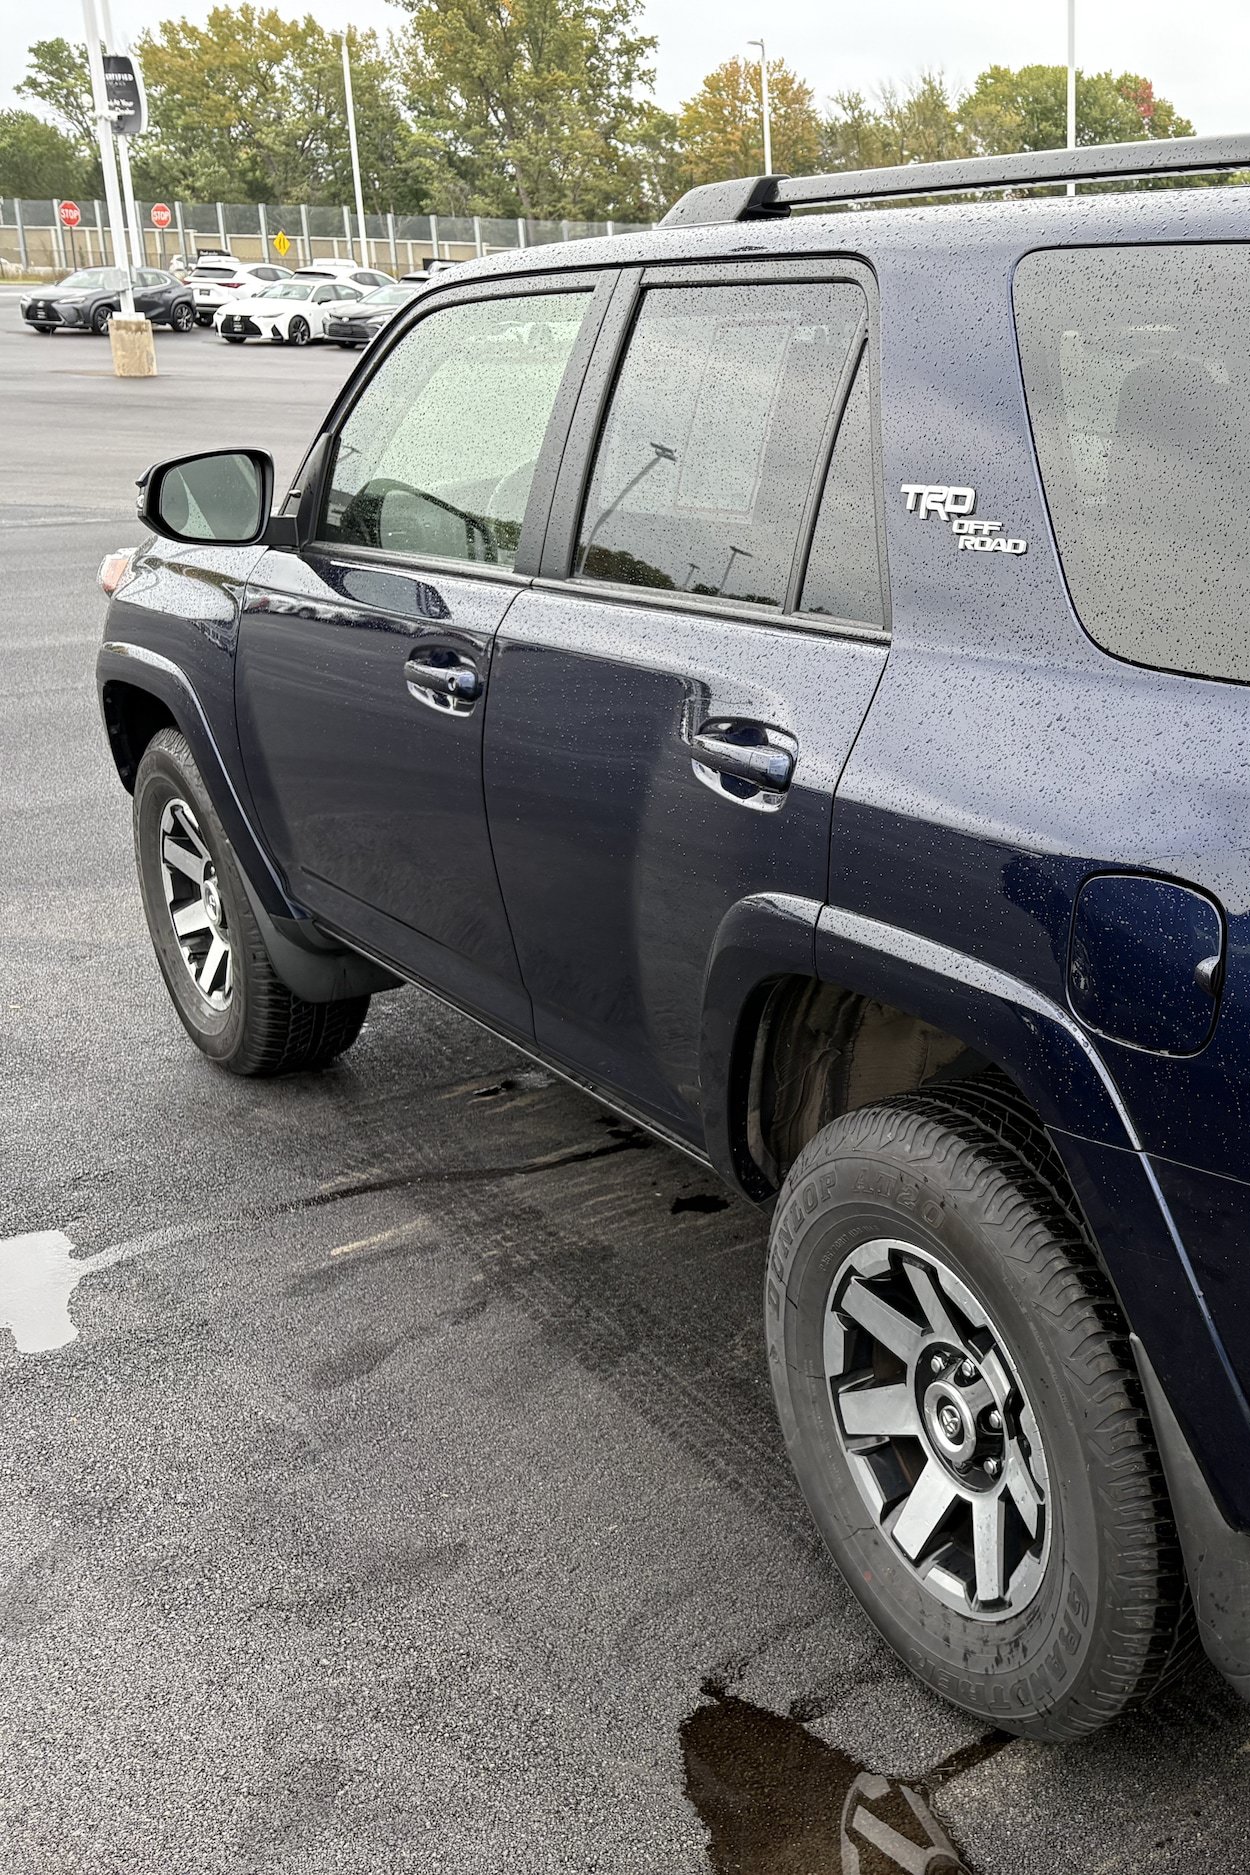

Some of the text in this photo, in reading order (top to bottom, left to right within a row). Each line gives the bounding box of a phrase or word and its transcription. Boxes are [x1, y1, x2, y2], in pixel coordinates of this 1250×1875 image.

[60, 208, 79, 219] STOP
[153, 210, 170, 220] STOP
[900, 484, 976, 521] TRD
[952, 519, 1003, 535] OFF
[958, 535, 1028, 555] ROAD
[767, 1167, 946, 1322] DUNLOP AT20
[908, 1572, 1090, 1710] GRANDTREK
